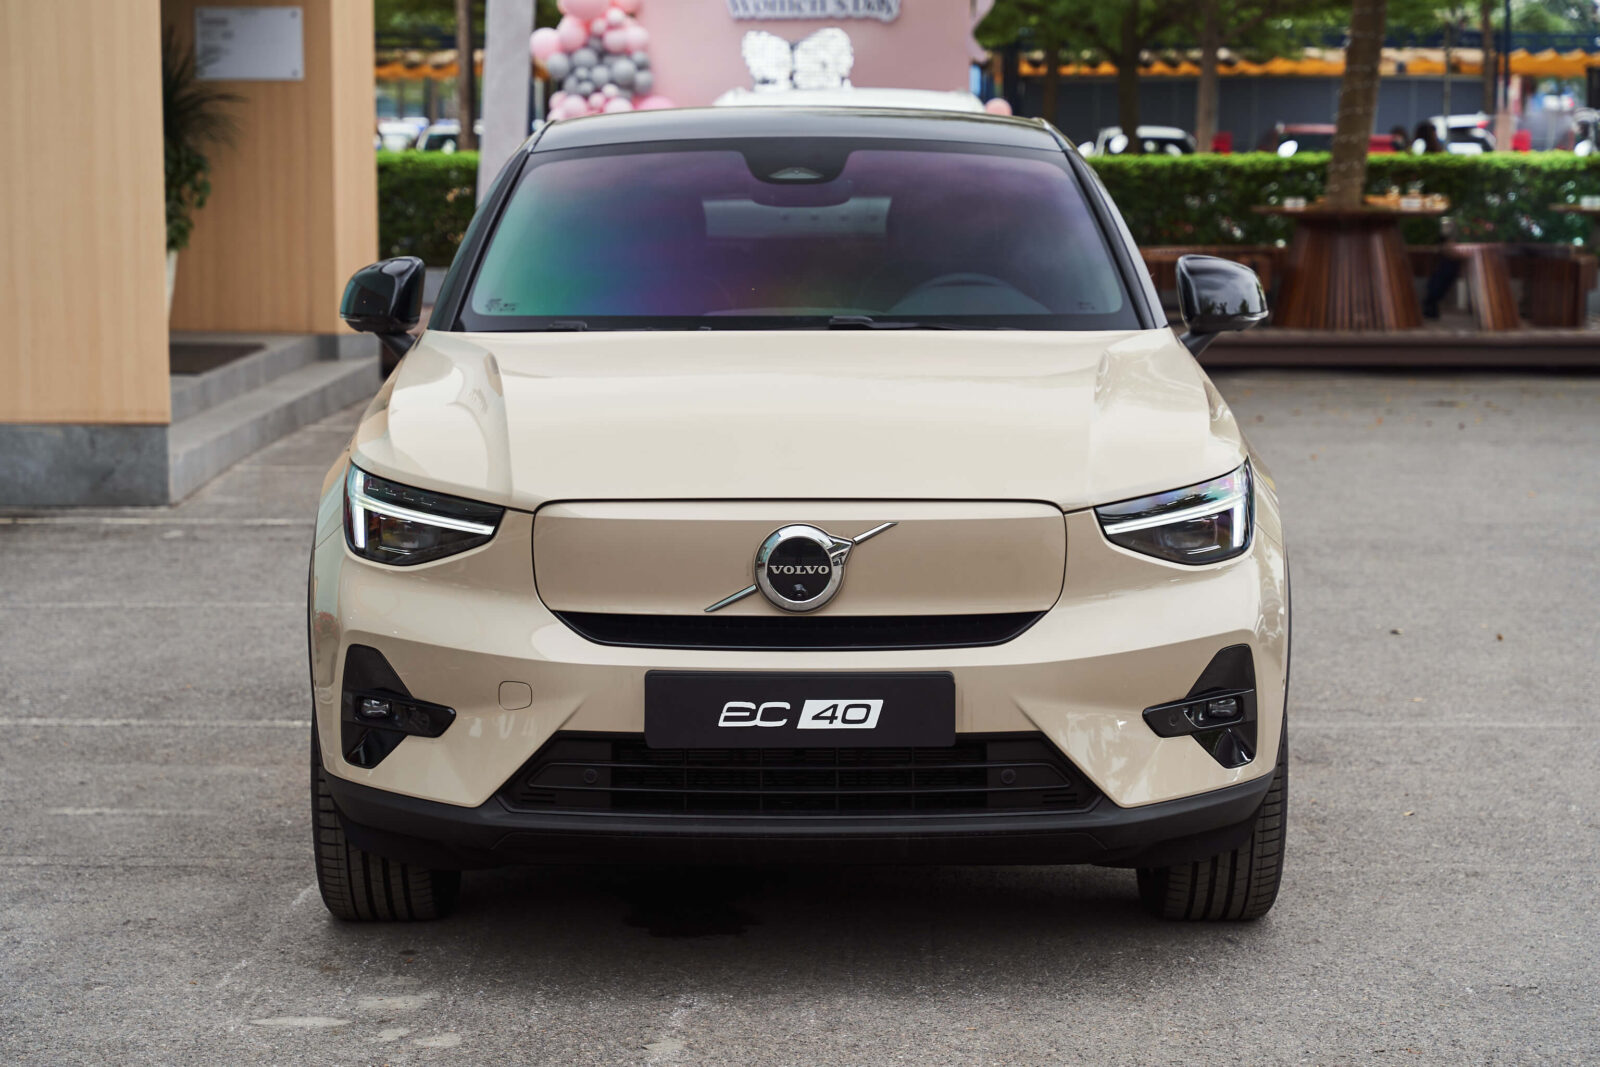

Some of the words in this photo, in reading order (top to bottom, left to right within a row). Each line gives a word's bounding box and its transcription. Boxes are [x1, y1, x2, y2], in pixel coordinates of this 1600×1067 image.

[730, 0, 847, 12] Womens
[769, 565, 829, 575] VOLVO
[718, 701, 791, 727] EC
[811, 703, 872, 725] 40
